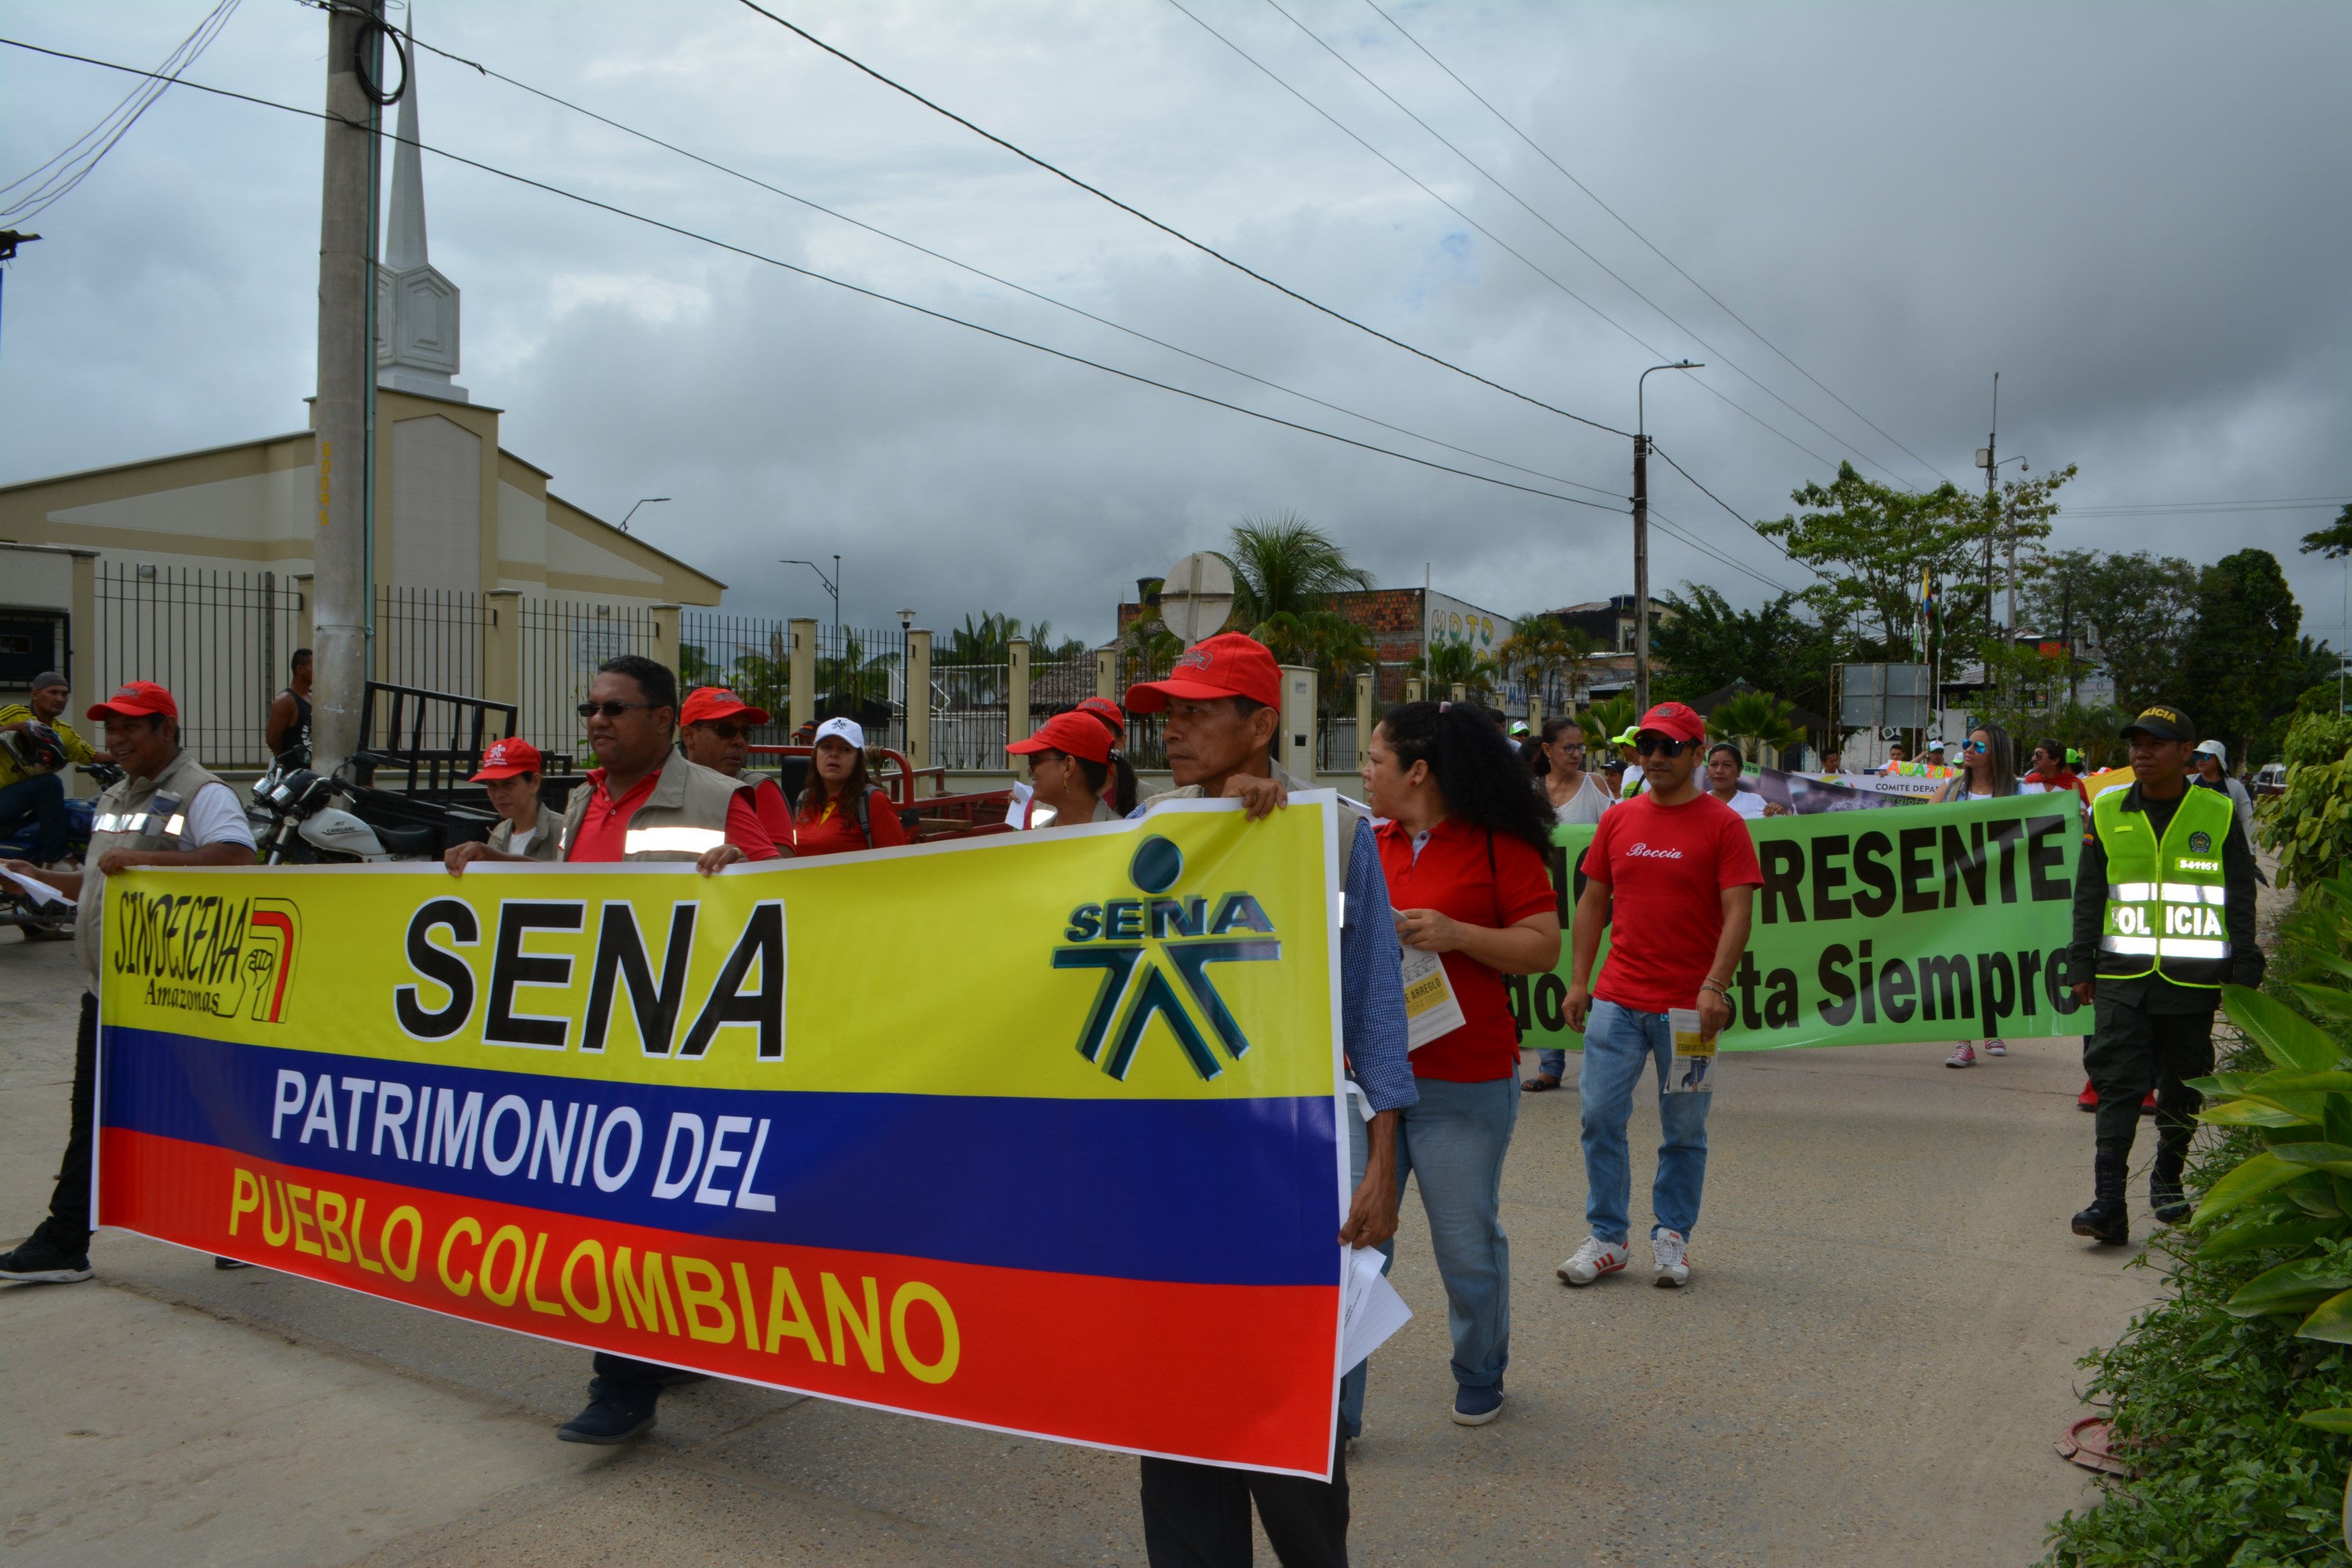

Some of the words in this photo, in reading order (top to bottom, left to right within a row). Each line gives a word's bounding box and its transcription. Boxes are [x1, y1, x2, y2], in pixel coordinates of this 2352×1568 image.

[582, 634, 623, 644] JESUCRSTO
[1431, 609, 1494, 647] MOTO
[2137, 707, 2176, 724] OLICIA
[1875, 783, 1911, 792] COMITÉ
[1886, 760, 1962, 779] AMAZONA
[1626, 843, 1684, 860] Boccia
[1759, 814, 2073, 924] RESENTE
[1064, 891, 1276, 942] SENA
[114, 891, 249, 985] SINDESENA
[144, 978, 220, 1014] Amazonas
[394, 895, 788, 1062] SENA
[1411, 978, 1442, 1000] ARREGLO
[1817, 938, 2082, 1038] Siempre
[271, 1069, 644, 1193] PATRIMONIO
[651, 1112, 777, 1213] DEL
[228, 1168, 423, 1283] PUEBLO
[437, 1216, 960, 1385] COLOMBIANO
